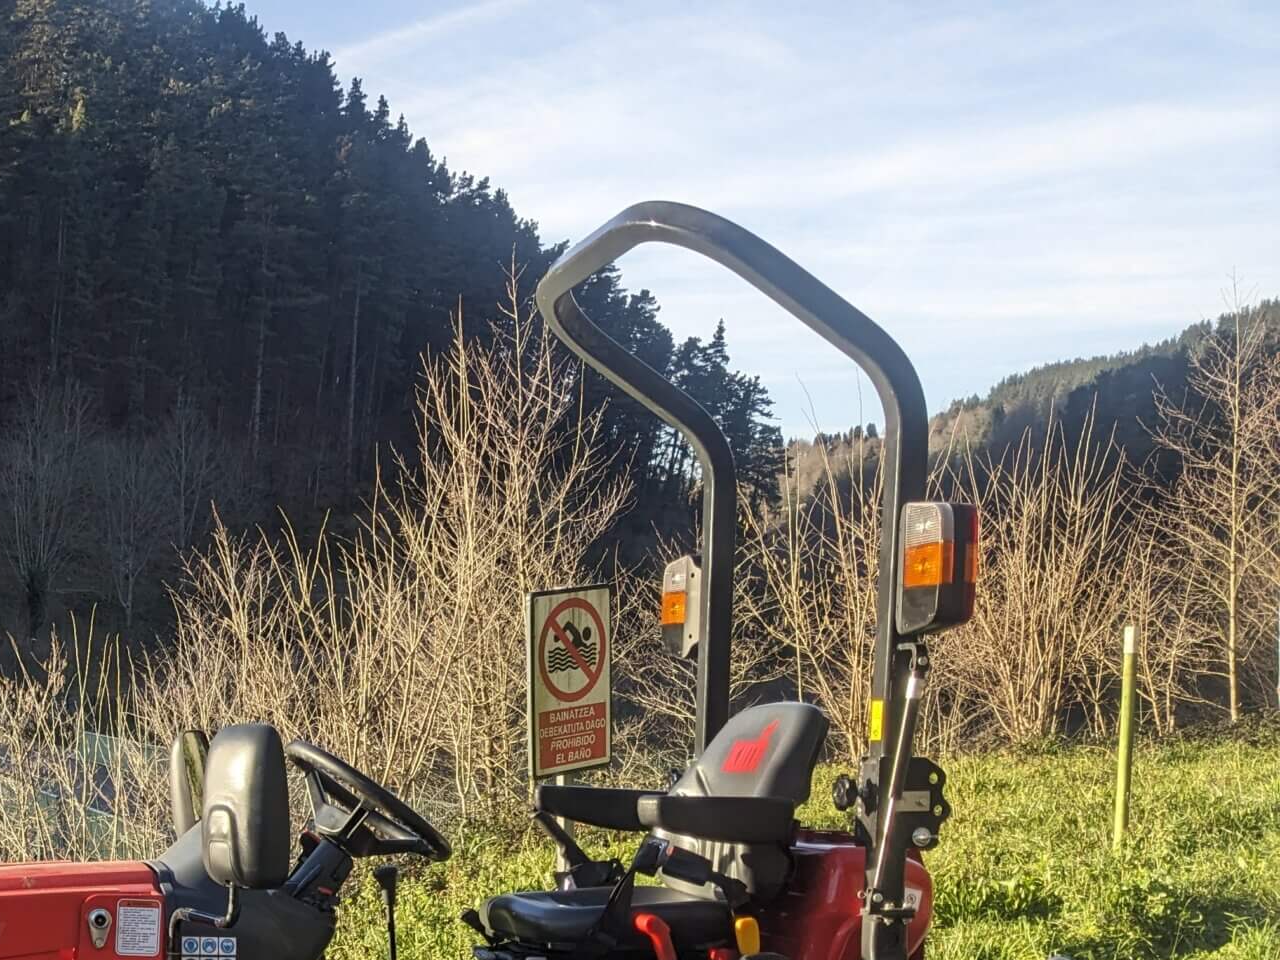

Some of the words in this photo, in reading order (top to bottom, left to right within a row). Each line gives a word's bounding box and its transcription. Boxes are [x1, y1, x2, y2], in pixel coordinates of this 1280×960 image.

[549, 706, 596, 723] BAINATZEA
[540, 722, 585, 738] DEBEKATUTA
[585, 718, 606, 731] DAGO
[550, 734, 597, 751] PROHIBIDO
[556, 753, 567, 764] EL
[568, 747, 592, 762] BAÑO
